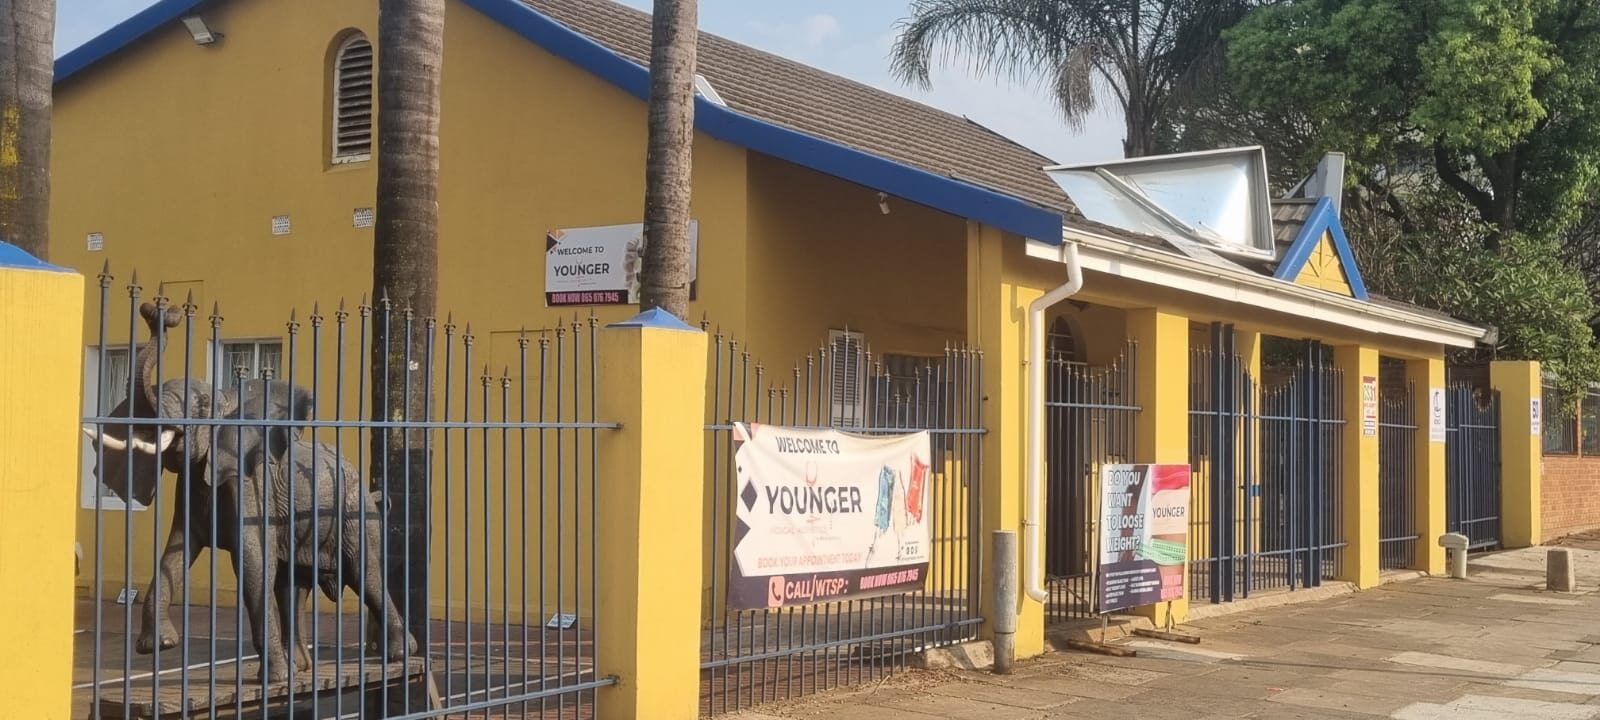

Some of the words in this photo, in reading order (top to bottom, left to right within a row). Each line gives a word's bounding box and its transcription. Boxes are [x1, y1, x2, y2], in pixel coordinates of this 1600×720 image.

[557, 247, 592, 256] WELCOME
[594, 246, 604, 254] TO
[554, 263, 610, 277] YOUNGER
[776, 436, 827, 454] WELCOME
[825, 440, 840, 455] TO
[1108, 470, 1120, 486] DO
[1121, 471, 1140, 486] YOU
[765, 485, 863, 515] YOUNGER
[1107, 492, 1133, 509] WANT
[1152, 506, 1185, 518] YOUNGER
[1106, 515, 1117, 530] TO
[1118, 513, 1144, 529] LOOSE
[1106, 535, 1140, 553] WEIGHT?
